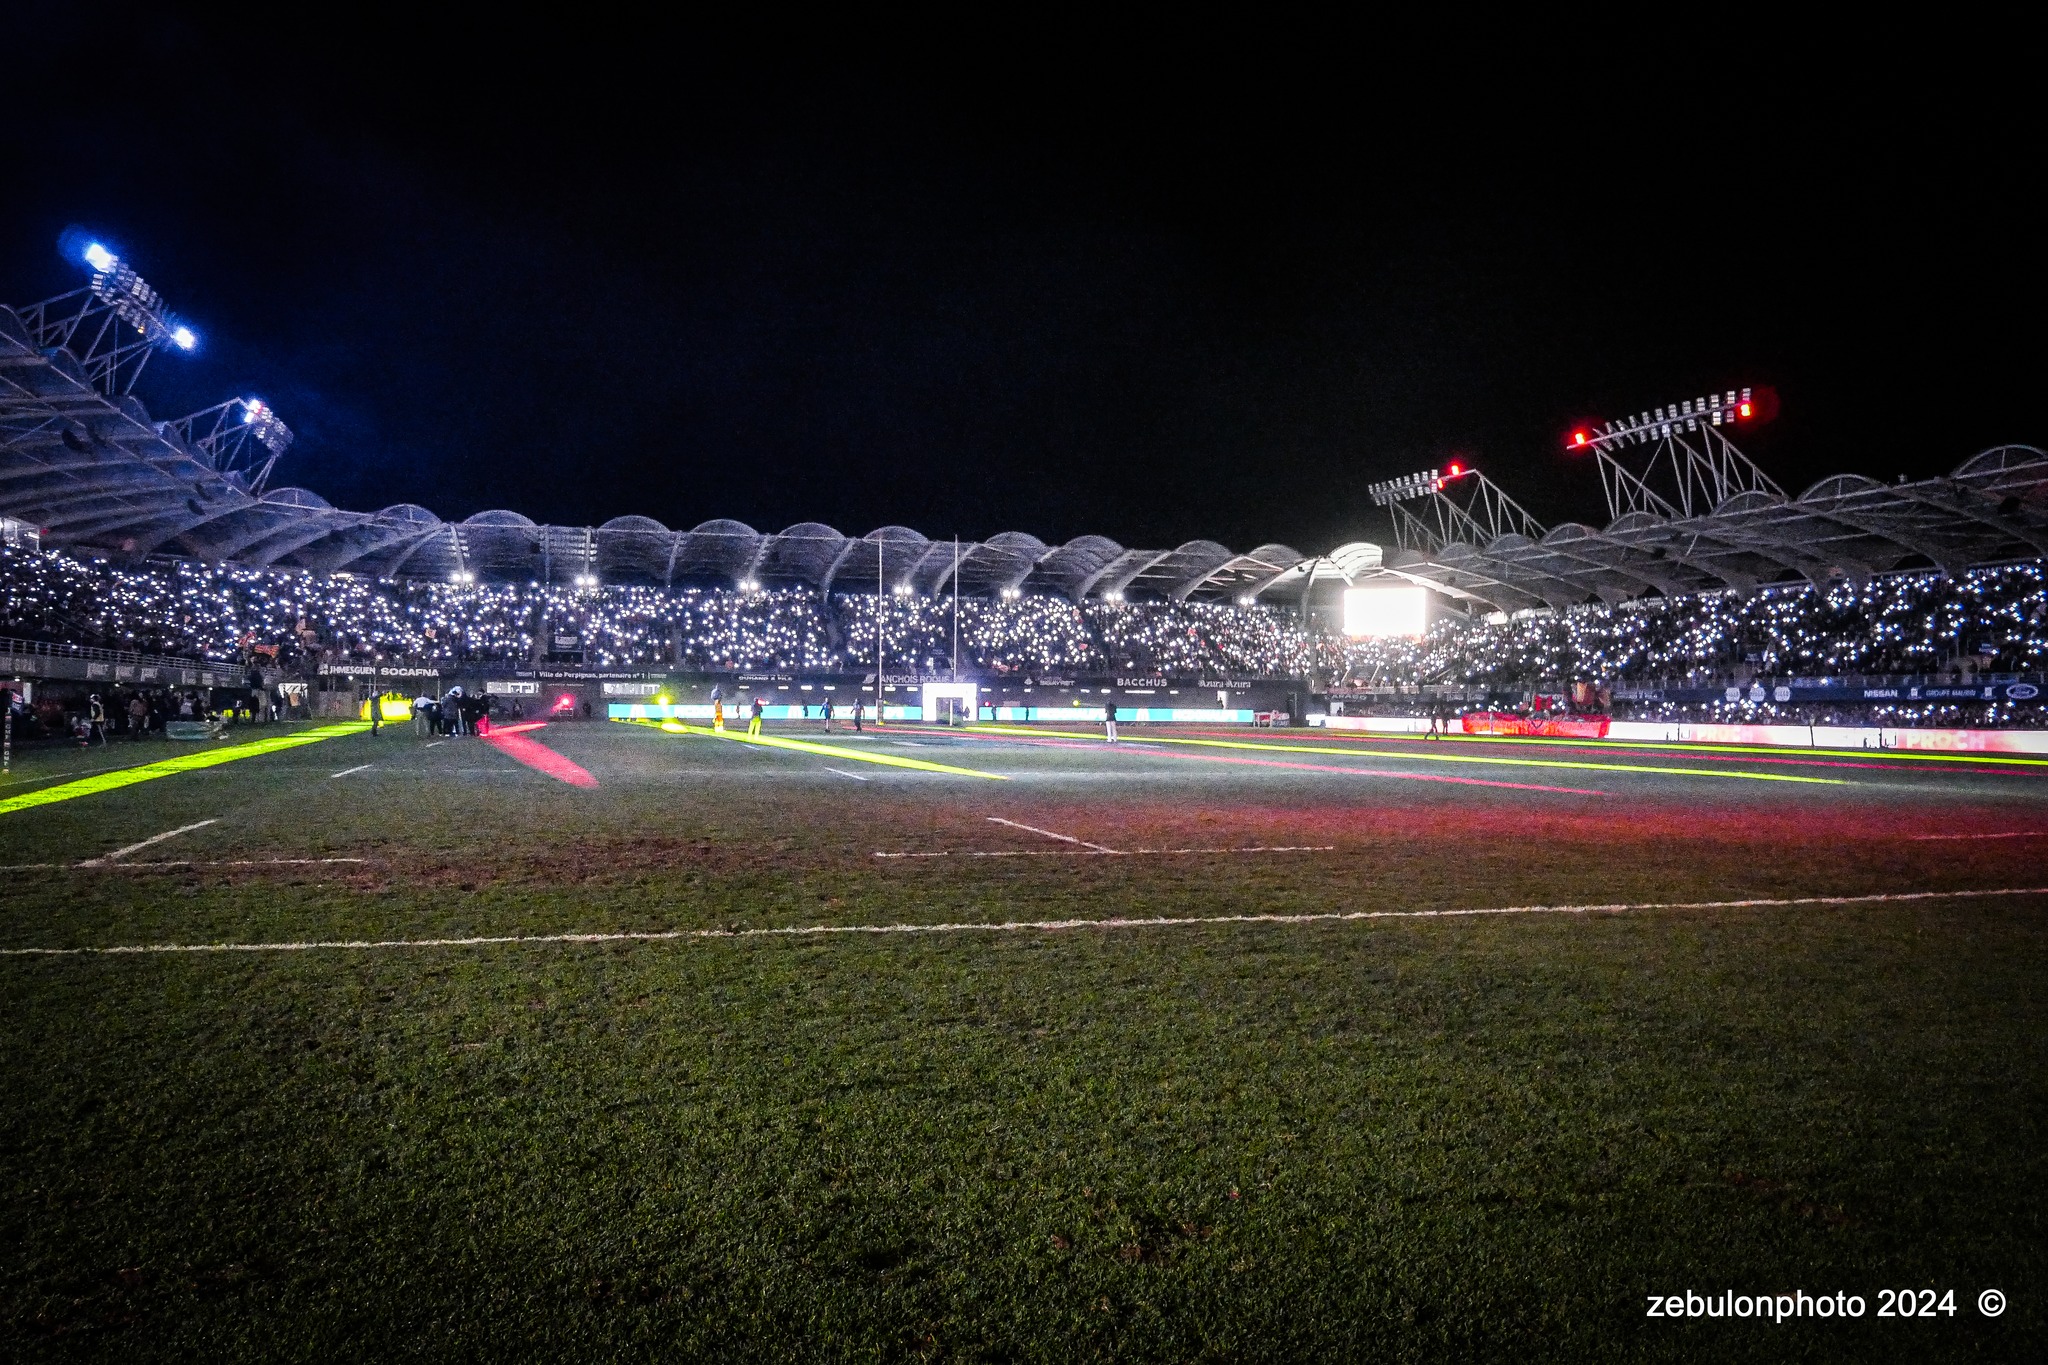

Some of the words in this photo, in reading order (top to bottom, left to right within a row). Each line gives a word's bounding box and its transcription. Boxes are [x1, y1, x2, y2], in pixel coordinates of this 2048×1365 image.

[380, 667, 439, 677] SOCAFNA
[599, 672, 632, 680] partenaire
[881, 674, 919, 684] ANCHOIS
[1116, 678, 1168, 687] BACCHUS
[1863, 689, 1898, 698] NISSAN
